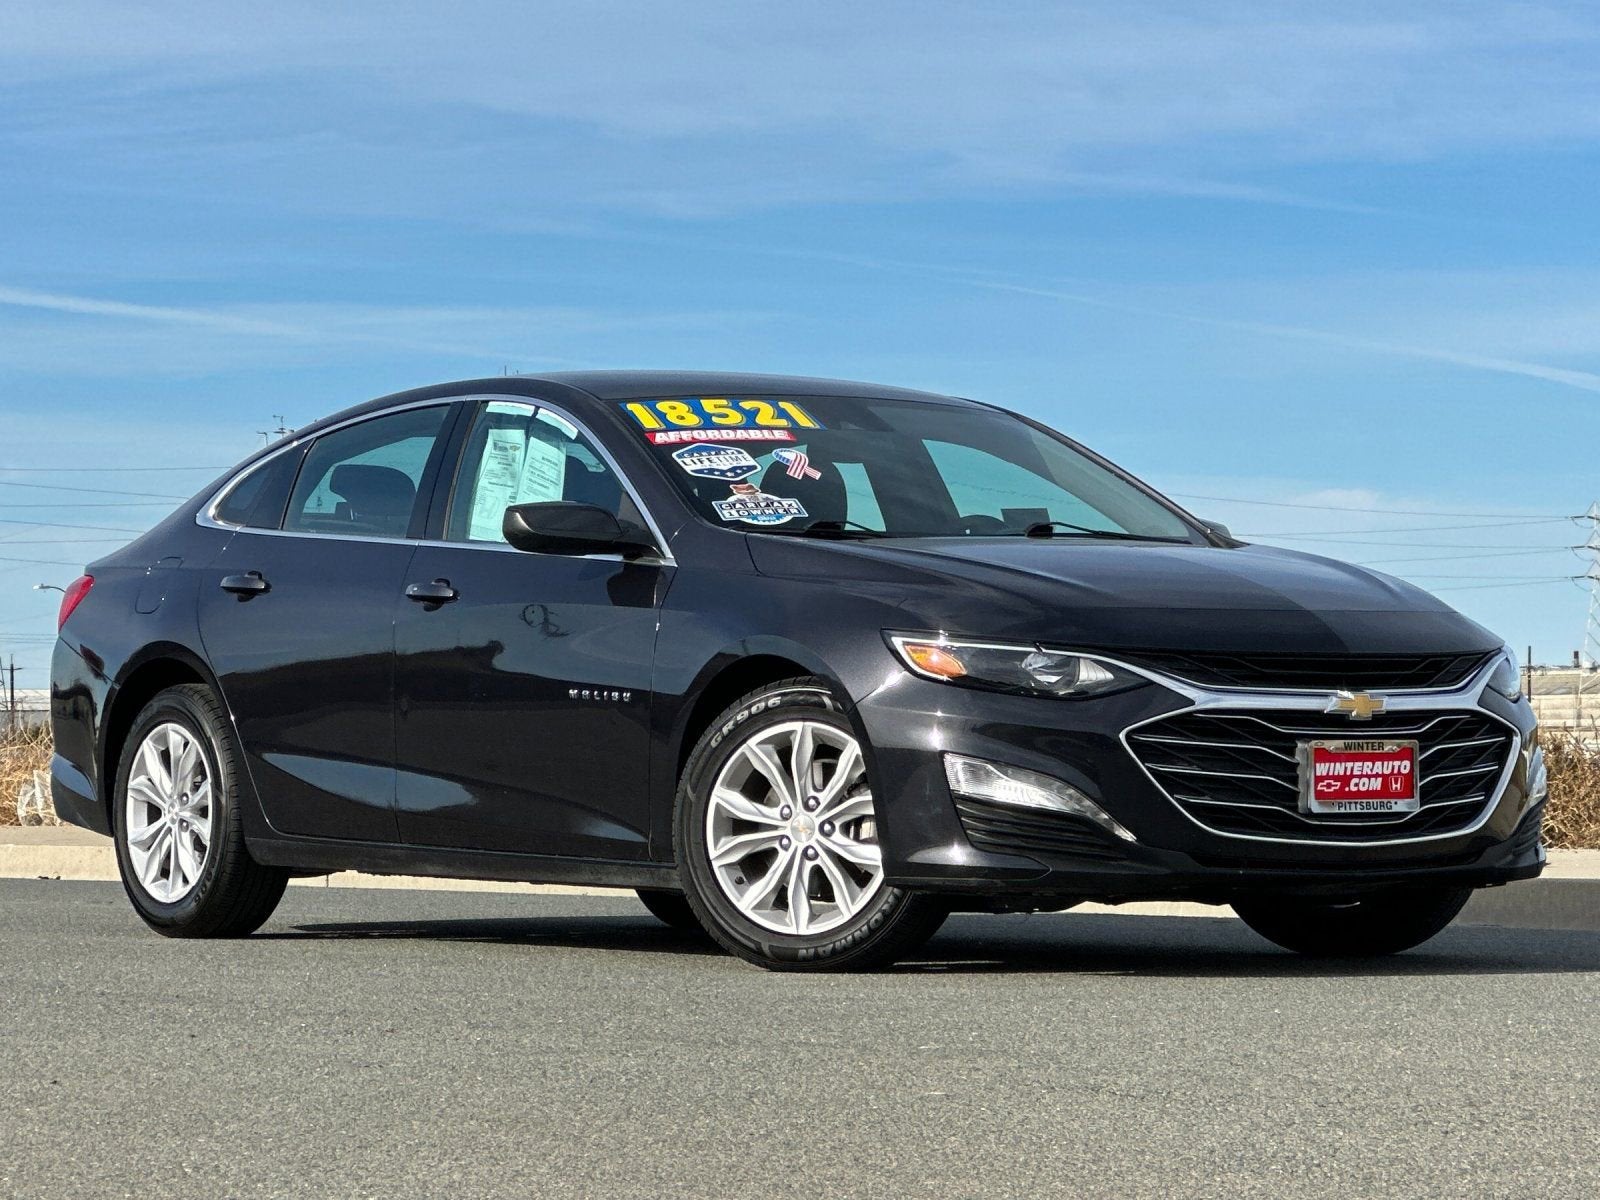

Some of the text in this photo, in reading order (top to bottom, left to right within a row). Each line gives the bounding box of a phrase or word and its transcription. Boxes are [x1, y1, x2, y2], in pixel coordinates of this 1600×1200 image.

[626, 399, 820, 429] 18521
[654, 429, 791, 443] AFFORDABLE
[681, 455, 751, 466] LIFETIME
[720, 501, 796, 510] CARFAX
[739, 508, 800, 516] OWNER
[568, 688, 631, 702] MALIBU
[710, 696, 782, 748] GR906
[1343, 741, 1385, 752] WINTER
[1315, 760, 1411, 776] WINTERAUTO
[1344, 777, 1383, 792] .COM
[1337, 800, 1393, 811] PITTSBURG
